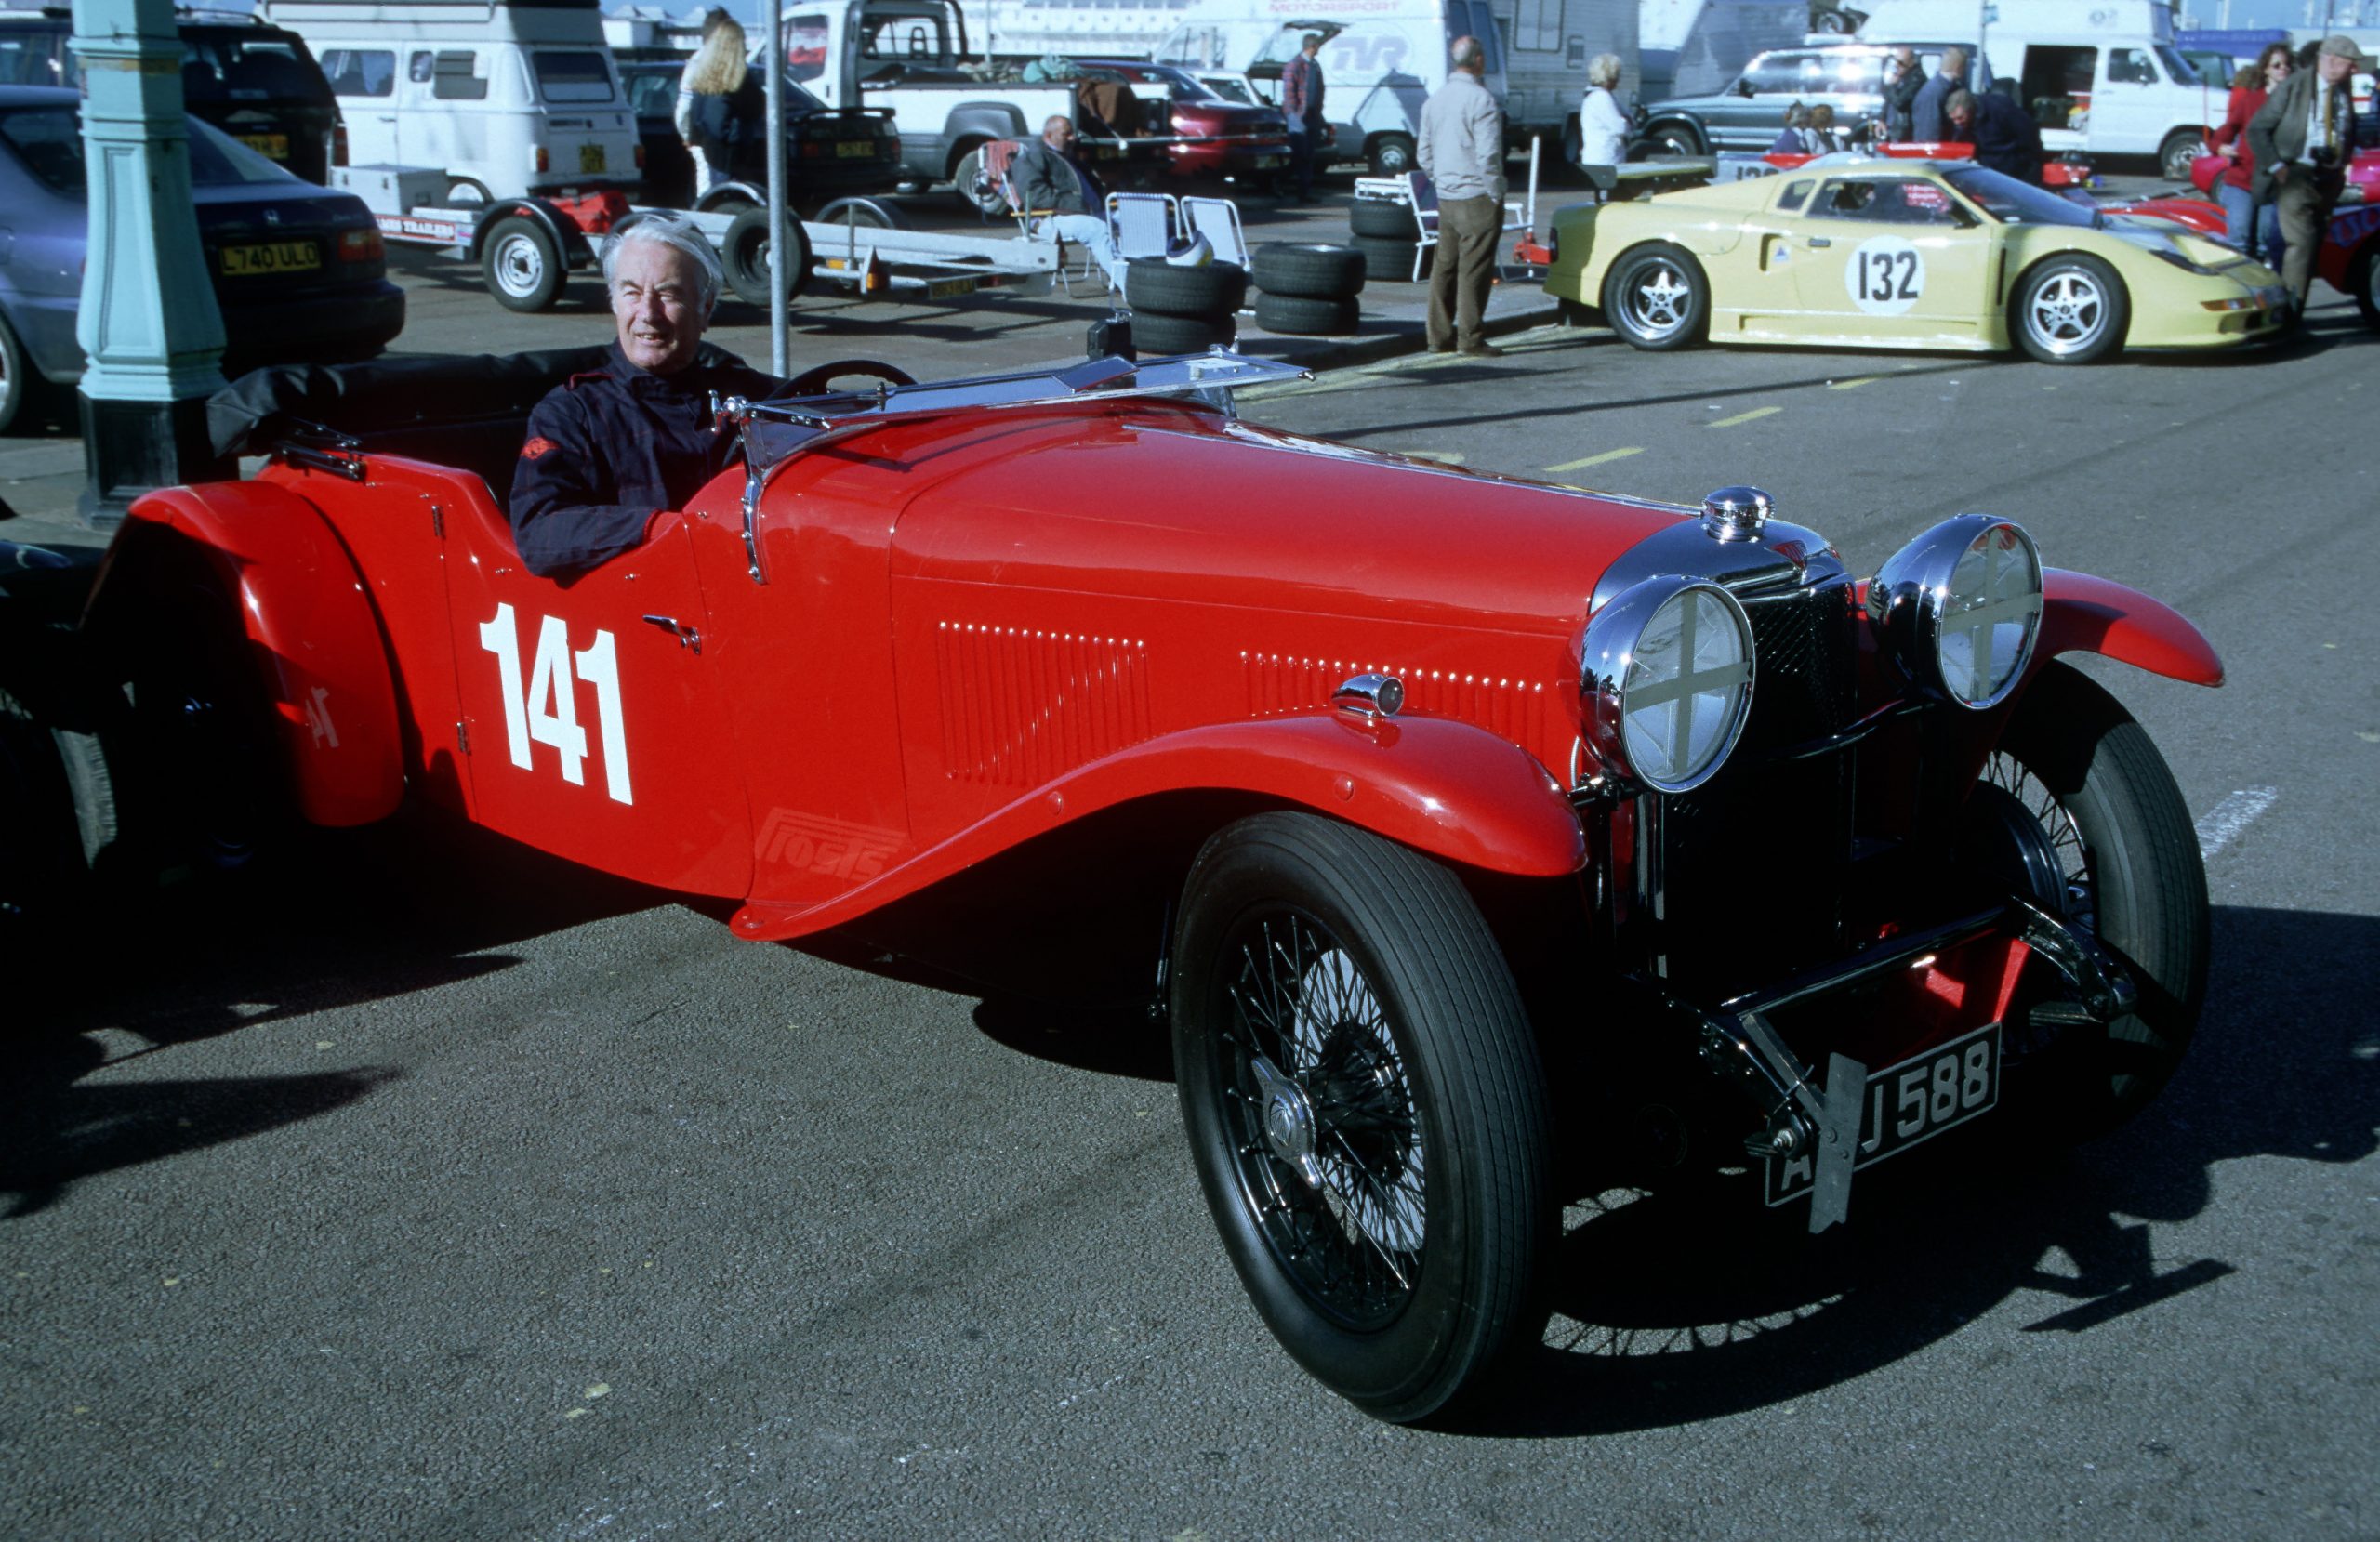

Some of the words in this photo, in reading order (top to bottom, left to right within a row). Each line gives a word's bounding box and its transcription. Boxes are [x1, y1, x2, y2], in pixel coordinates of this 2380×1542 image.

[1269, 2, 1398, 12] MOTORSPORT
[1329, 36, 1409, 72] TVR
[223, 247, 275, 270] L740
[1859, 250, 1919, 302] 132
[479, 601, 633, 806] 141
[1897, 1040, 1990, 1138] 588
